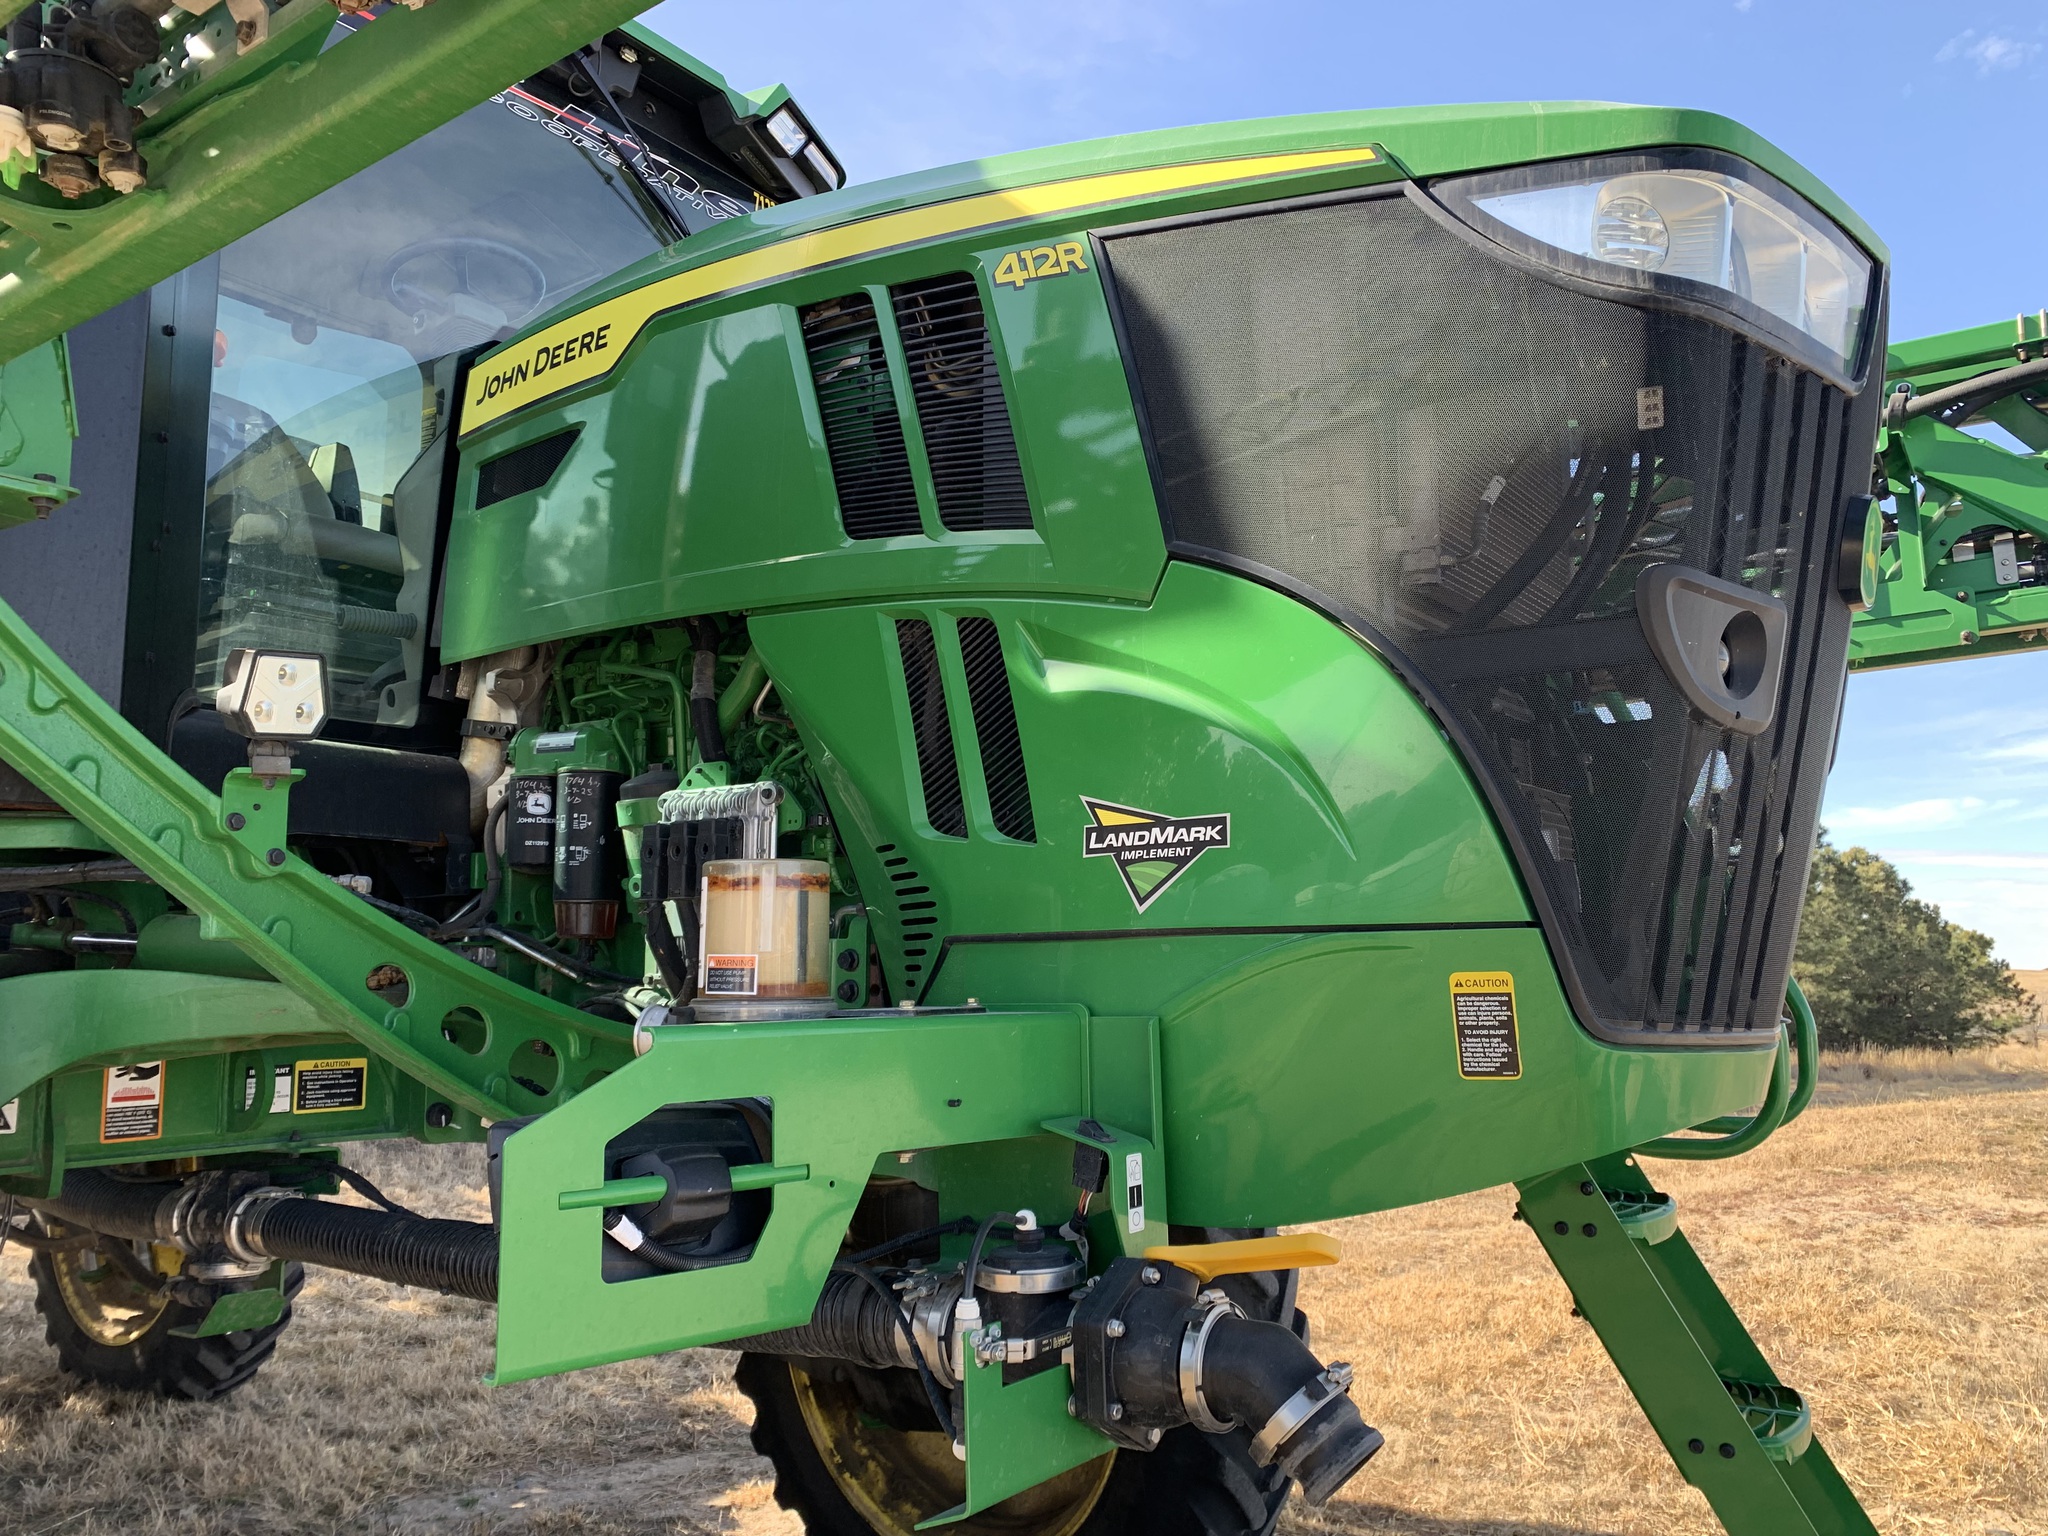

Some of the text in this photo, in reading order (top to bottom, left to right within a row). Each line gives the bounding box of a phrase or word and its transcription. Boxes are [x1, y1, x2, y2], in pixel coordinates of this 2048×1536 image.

[993, 242, 1089, 290] 412R
[476, 324, 611, 406] JOHN DEERE
[516, 781, 536, 790] 1704
[1120, 846, 1194, 860] IMPLEMENT
[1464, 979, 1509, 988] CAUTION
